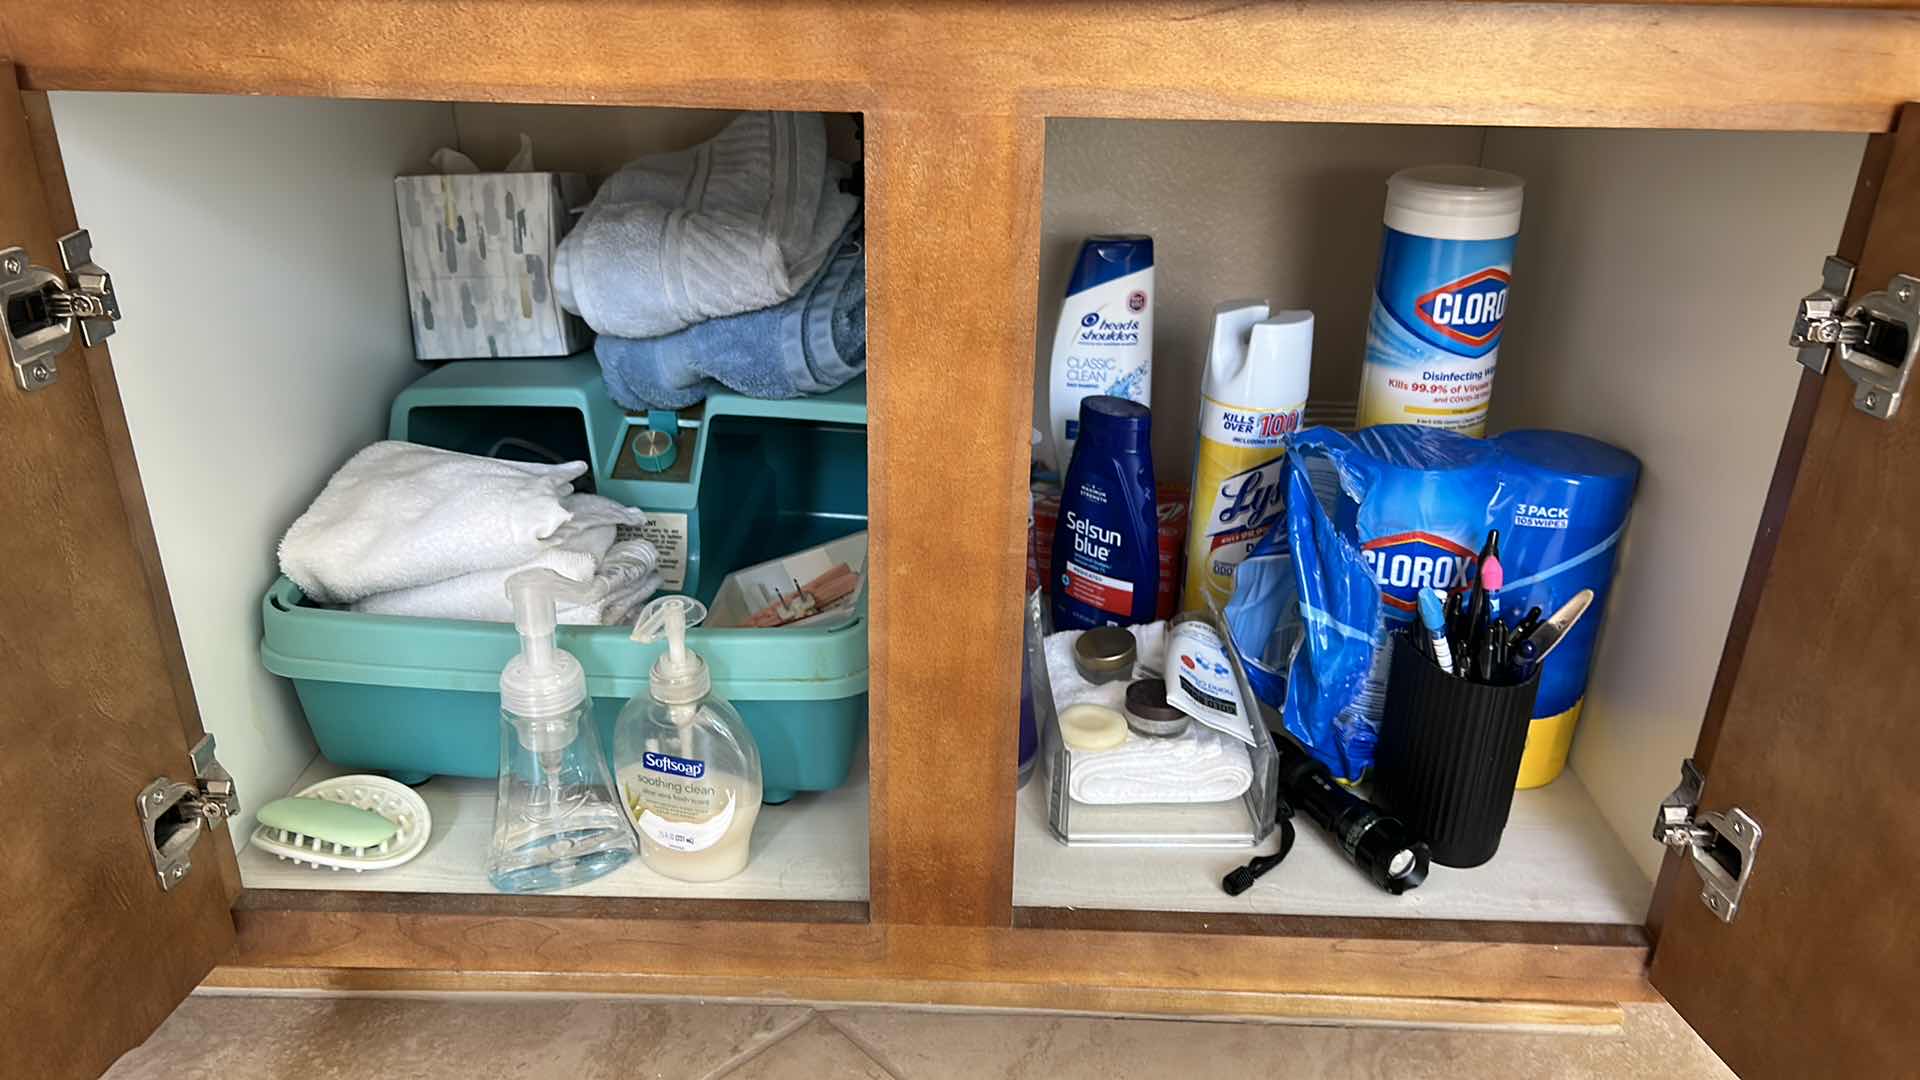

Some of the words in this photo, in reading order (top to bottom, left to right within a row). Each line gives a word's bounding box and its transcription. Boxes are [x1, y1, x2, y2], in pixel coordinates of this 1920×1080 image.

[1432, 290, 1508, 325] CLORO
[1081, 331, 1139, 343] shoulders
[1067, 356, 1116, 370] CLASSIC
[1067, 370, 1106, 383] CLEAN
[1423, 370, 1483, 381] Disinfecting
[1388, 379, 1408, 391] Kills
[1411, 383, 1448, 393] 99.9%
[1450, 385, 1461, 393] of
[1223, 412, 1255, 425] KILLS
[1223, 422, 1254, 434] OVER
[1219, 470, 1281, 527] Lys
[1516, 504, 1527, 515] 3
[1528, 506, 1569, 518] PACK
[1066, 511, 1122, 547] Selsun
[1517, 517, 1534, 526] 105
[1534, 519, 1568, 528] WIPES
[1074, 533, 1110, 561] blue
[645, 753, 703, 777] Softsoap
[638, 774, 682, 794] soothing
[684, 783, 716, 796] clean
